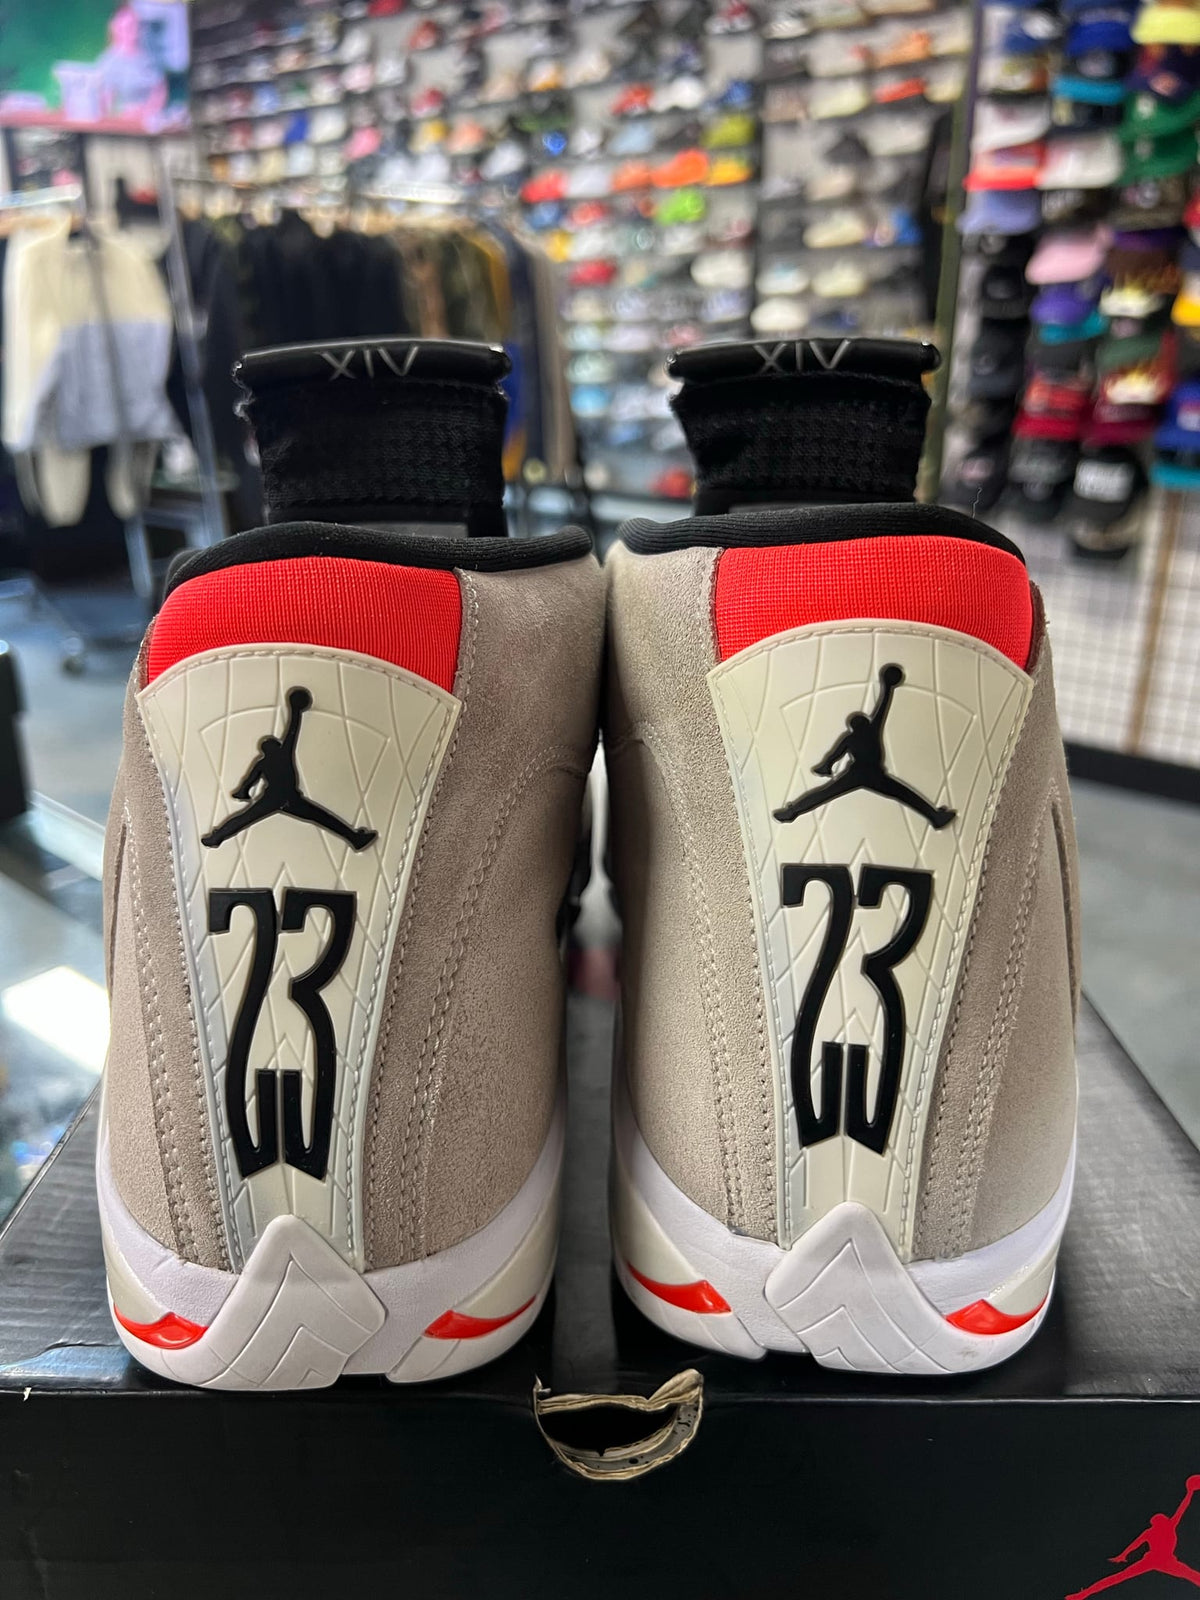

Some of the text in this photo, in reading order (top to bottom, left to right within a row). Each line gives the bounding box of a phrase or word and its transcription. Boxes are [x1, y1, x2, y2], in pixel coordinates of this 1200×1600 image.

[320, 346, 419, 381] XIV
[752, 339, 851, 375] XIV
[208, 886, 357, 1181] 23
[780, 863, 934, 1157] 23
